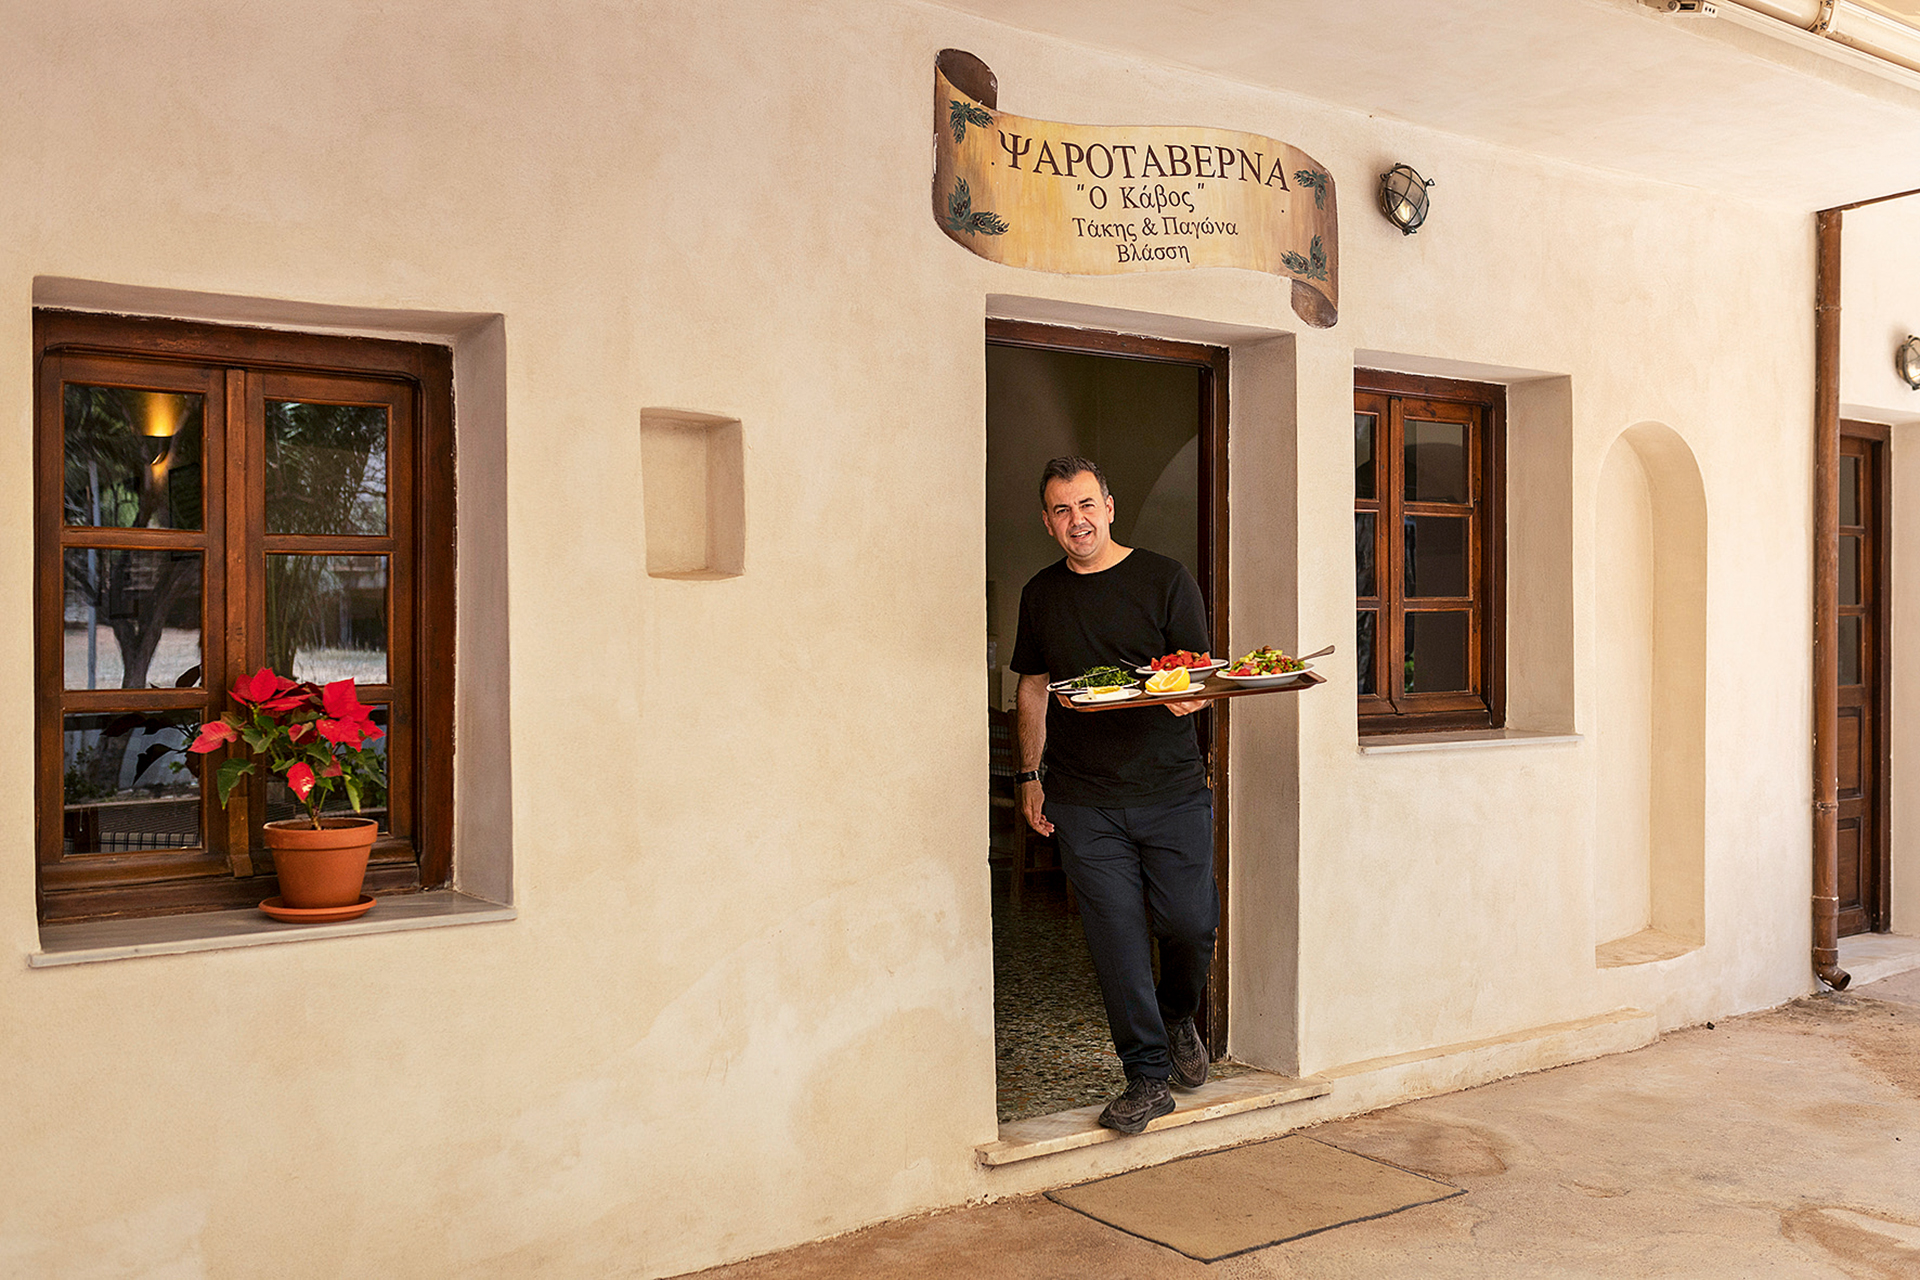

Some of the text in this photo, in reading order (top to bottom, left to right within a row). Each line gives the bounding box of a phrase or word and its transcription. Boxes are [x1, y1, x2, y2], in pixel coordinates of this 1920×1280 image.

[998, 129, 1291, 192] ΨΑΡΟΤΑΒΕΡΝΑ
[1077, 184, 1108, 210] "Ο
[1073, 216, 1239, 241] Τάκης & Παγώνα
[1116, 242, 1191, 263] Βλάσση
